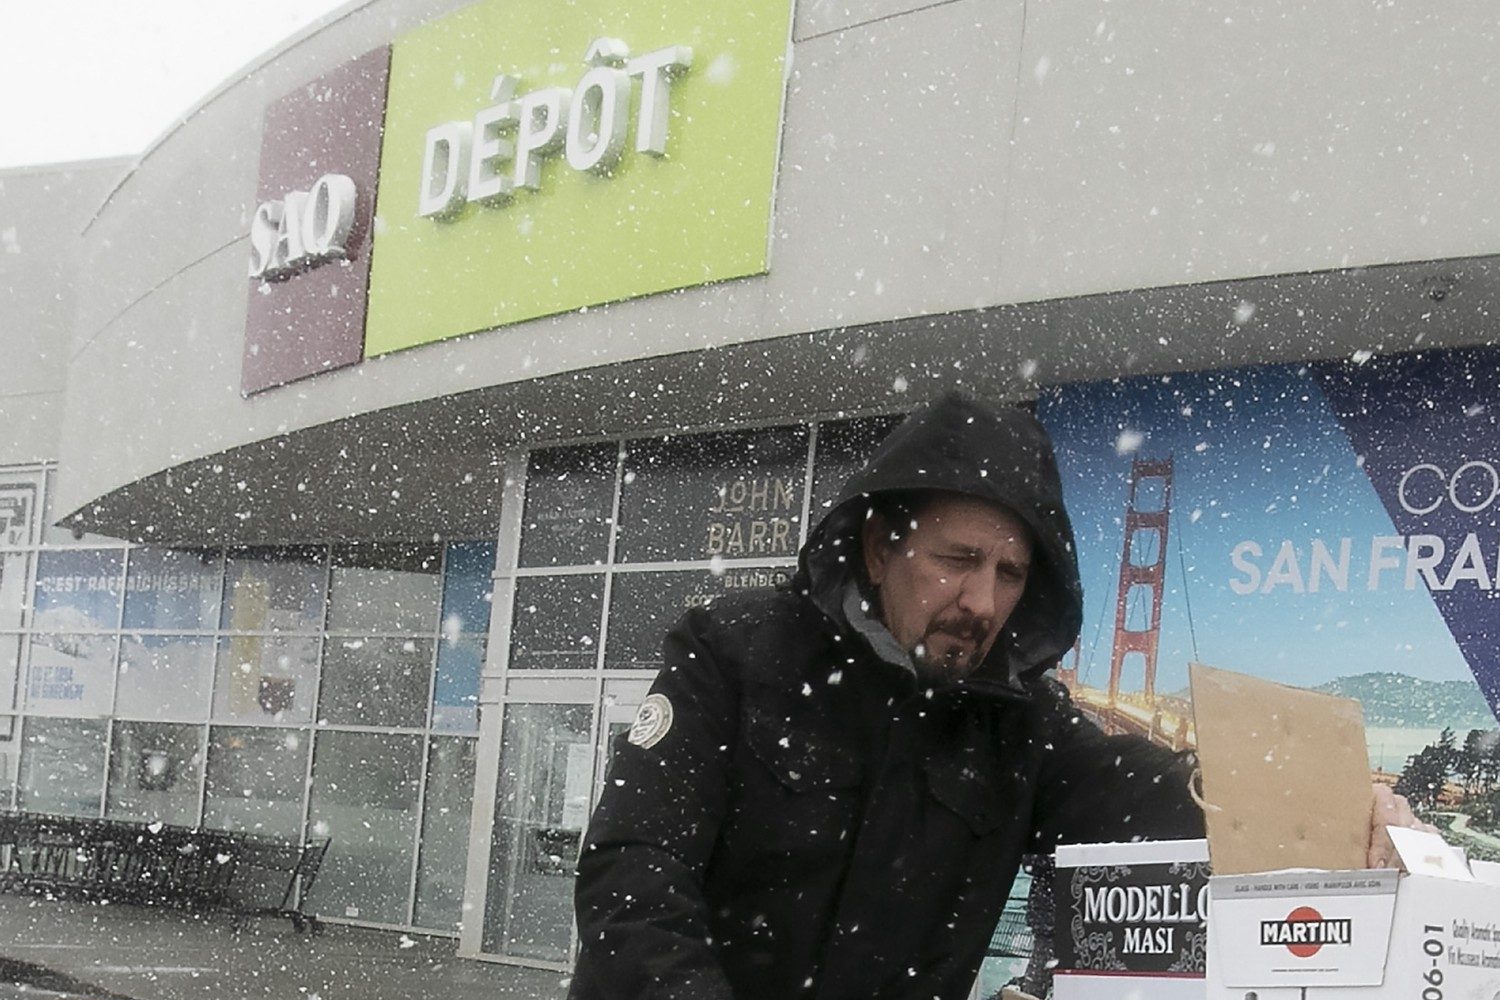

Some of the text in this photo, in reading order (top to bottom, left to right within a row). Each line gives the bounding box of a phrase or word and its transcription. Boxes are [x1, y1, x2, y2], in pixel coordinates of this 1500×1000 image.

[419, 36, 692, 221] DÉPÔT
[249, 173, 356, 278] SAQ
[713, 478, 794, 513] JOHN
[707, 520, 791, 554] BARR
[724, 573, 787, 588] BLENDED
[1229, 537, 1352, 595] SAN
[1122, 927, 1174, 953] MASI
[1263, 921, 1348, 944] MARTINI
